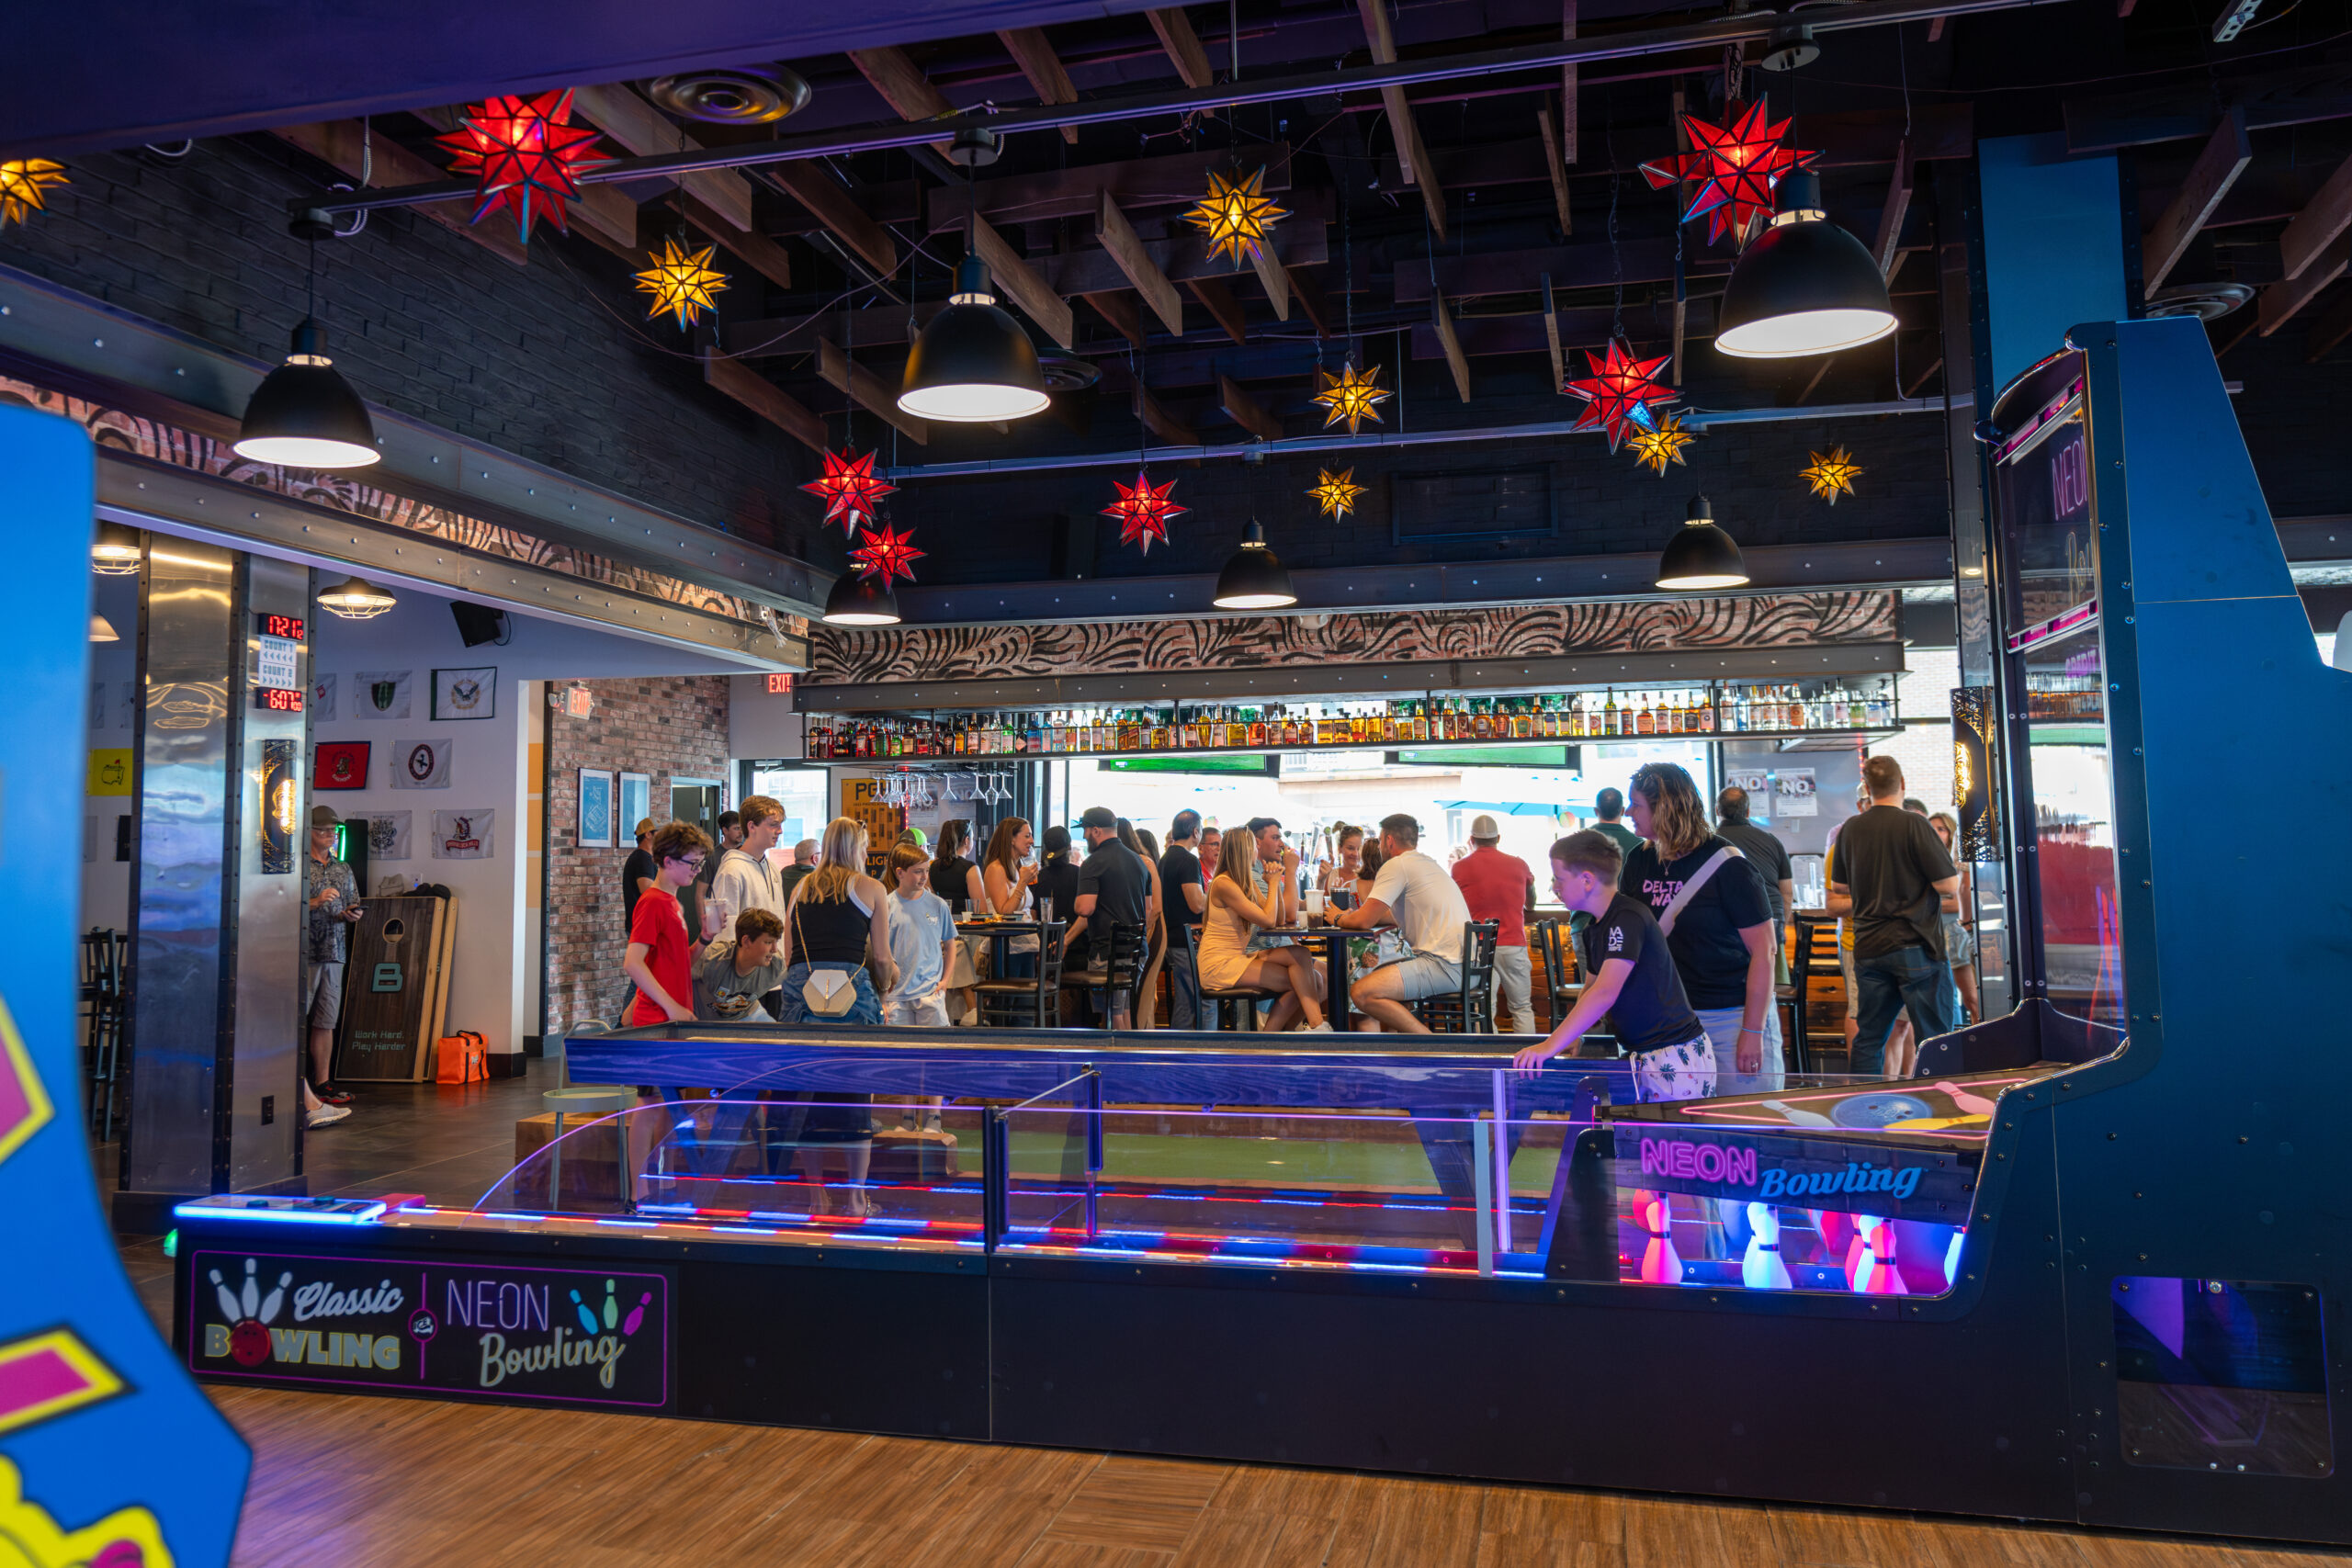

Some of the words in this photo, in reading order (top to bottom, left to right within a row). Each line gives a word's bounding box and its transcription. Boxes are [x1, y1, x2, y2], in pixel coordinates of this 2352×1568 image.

[264, 639, 287, 652] COURT
[263, 664, 286, 677] COURT
[288, 668, 293, 678] 2
[769, 673, 792, 694] EXIT
[571, 689, 590, 716] EXIT
[1735, 777, 1762, 791] NO
[1782, 780, 1810, 794] NO
[1643, 879, 1684, 894] DELTA
[1650, 893, 1676, 907] WA
[371, 963, 403, 993] B
[355, 1030, 377, 1039] Work
[380, 1030, 405, 1039] Hard.
[352, 1041, 370, 1053] Play
[374, 1041, 406, 1051] Harder
[1640, 1137, 1758, 1186] NEON
[1759, 1162, 1922, 1200] Bowling
[293, 1279, 404, 1323] Classic
[447, 1279, 549, 1332] NEON
[479, 1325, 627, 1389] Bowling
